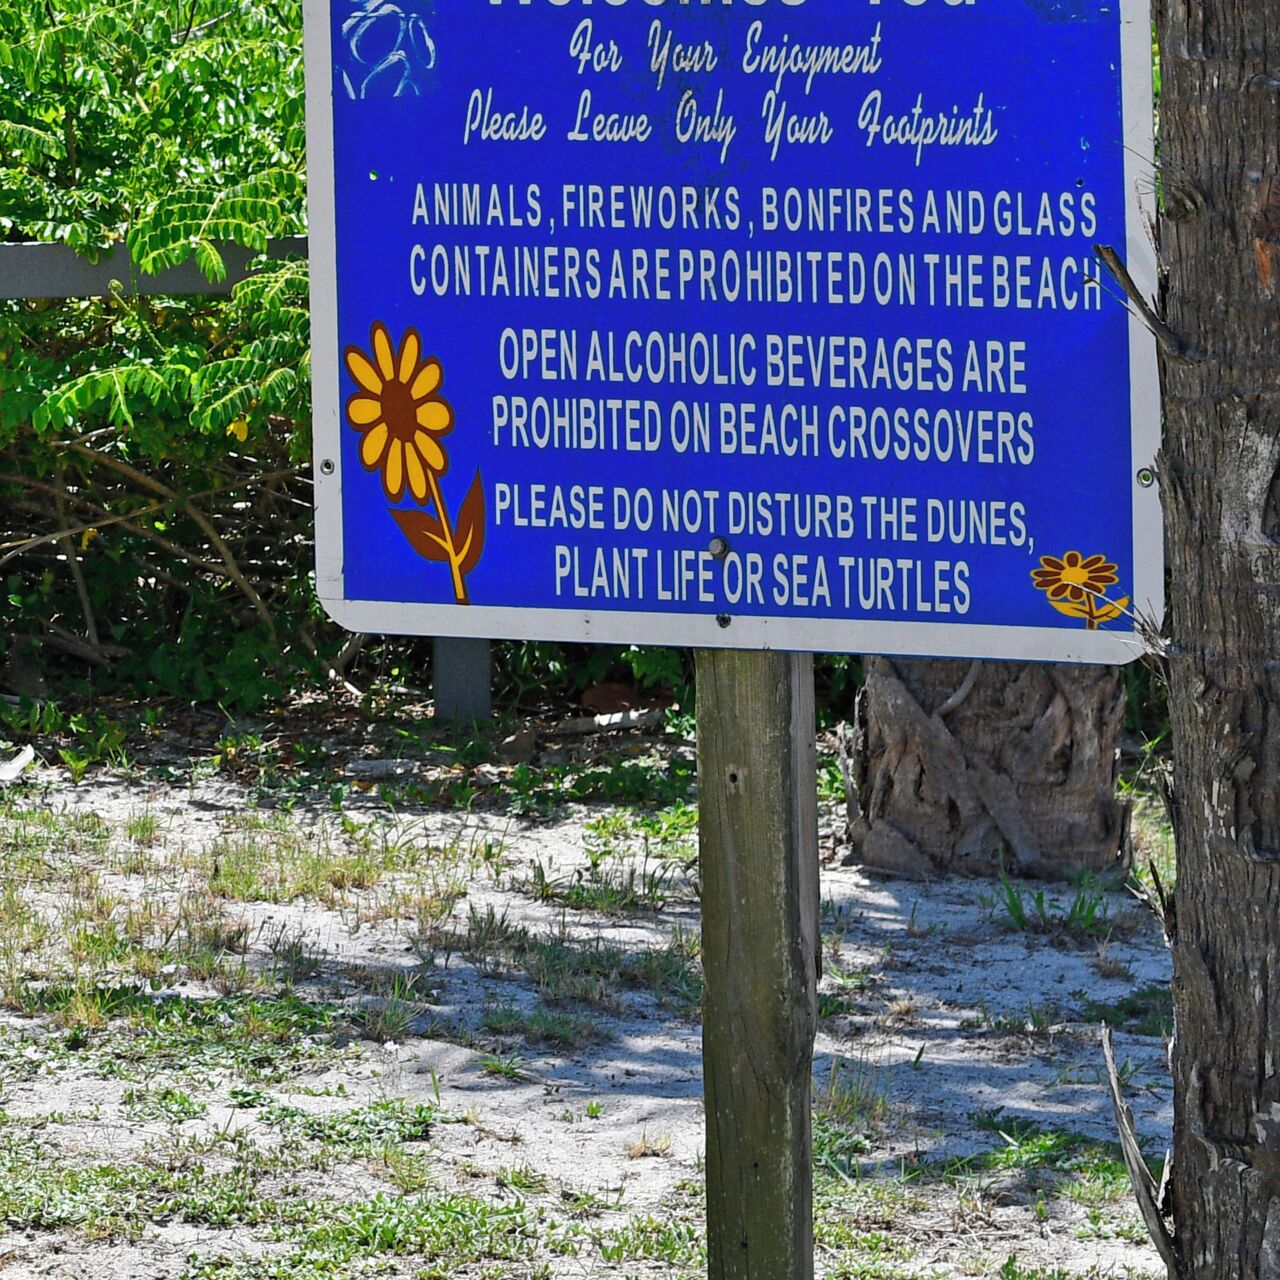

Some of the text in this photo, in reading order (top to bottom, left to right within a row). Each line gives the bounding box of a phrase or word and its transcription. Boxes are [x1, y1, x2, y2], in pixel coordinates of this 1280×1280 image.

[570, 19, 881, 94] For Your Enjoyment
[464, 88, 997, 166] Please Leave Only Your Footprints
[763, 188, 913, 233] BONFIRES
[922, 190, 984, 234] AND
[994, 191, 1096, 237] GLASS
[410, 245, 1100, 310] CONTAINERS ARE PROHIBITED ON THE BEACH
[500, 328, 1026, 393] OPEN ALCOHOLIC BEVERAGES ARE
[493, 396, 1034, 464] PROHIBITED ON BEACH CROSSOVERS
[496, 483, 1033, 554] PLEASE DO NOT DISTURB THE DUNES,
[556, 546, 970, 613] PLANT LIFE OR SEA TURTLES
